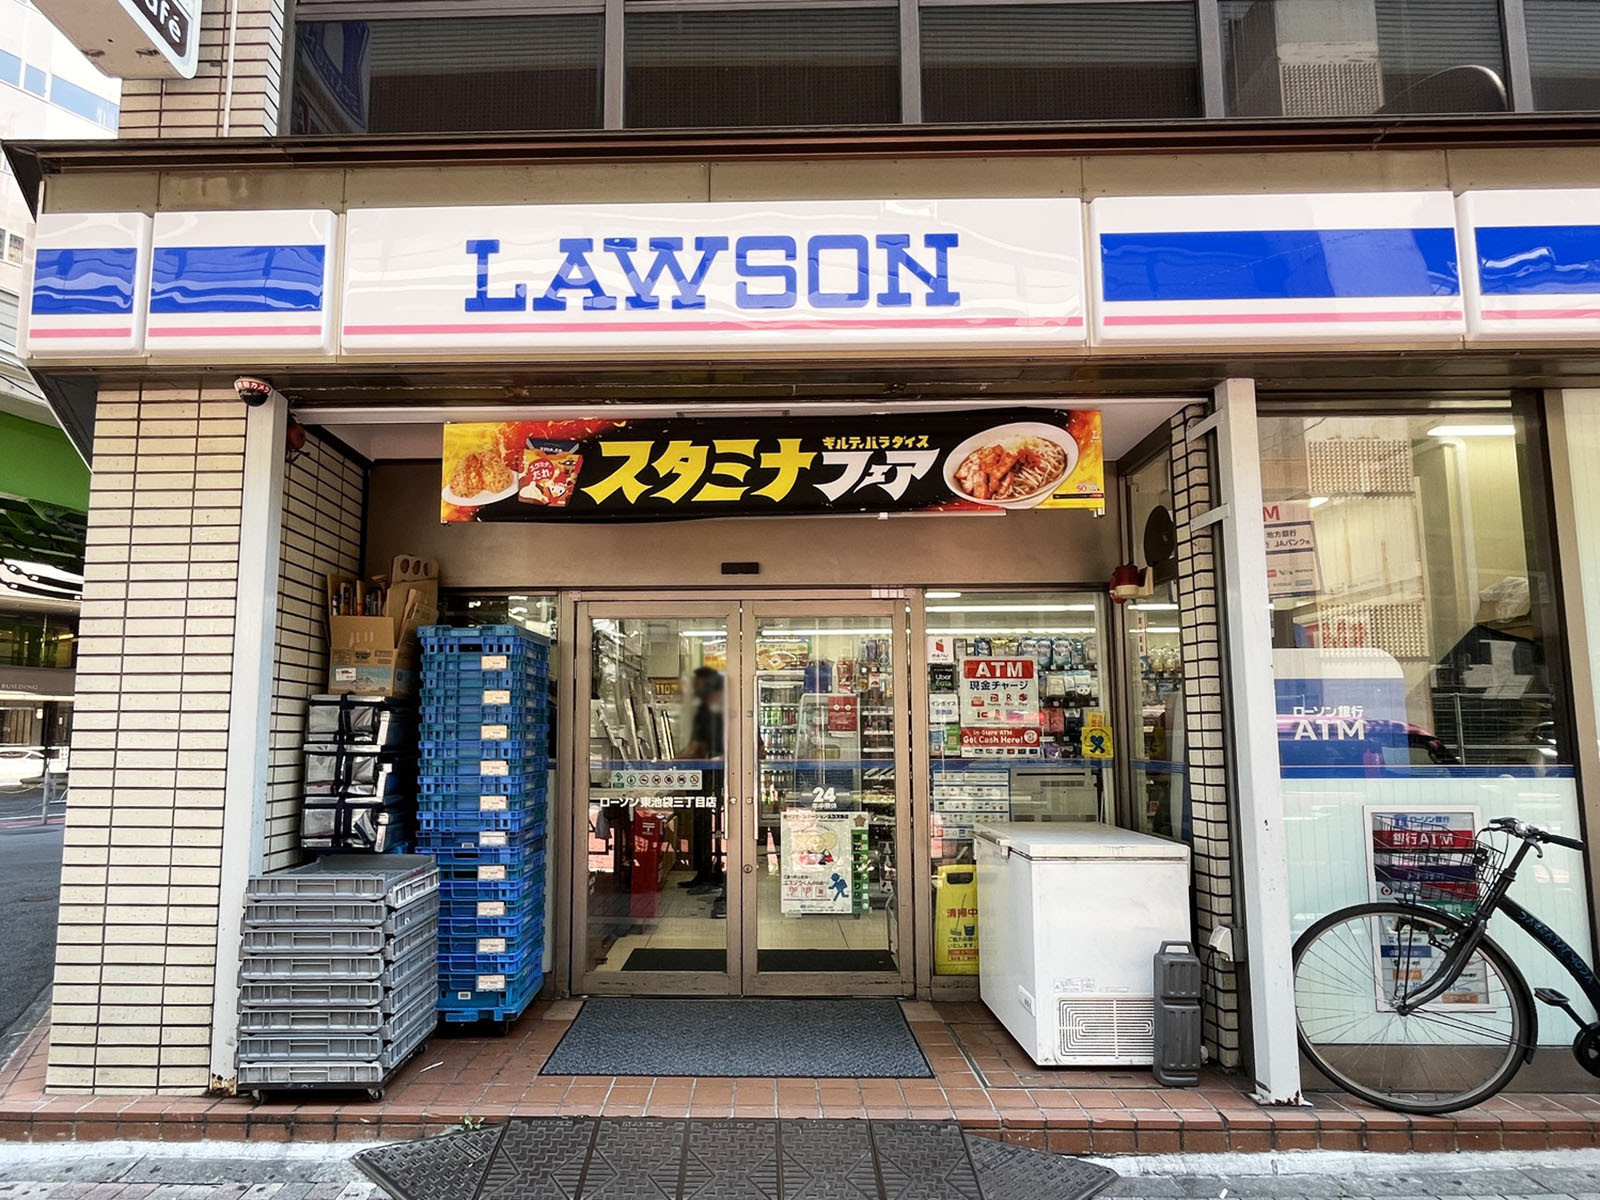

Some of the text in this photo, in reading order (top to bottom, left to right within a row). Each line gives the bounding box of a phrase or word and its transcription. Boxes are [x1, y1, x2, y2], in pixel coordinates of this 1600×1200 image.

[465, 233, 960, 311] LAWSON
[975, 661, 1023, 677] ATM
[969, 680, 1029, 690] 現金チャージ
[1293, 705, 1364, 718] ローソン銀行
[1293, 719, 1365, 740] ATM
[963, 736, 1023, 744] Get Cash Here!
[812, 787, 836, 803] 24
[600, 796, 717, 808] ローソン東池袋三丁目店
[946, 907, 978, 918] 清掃中
